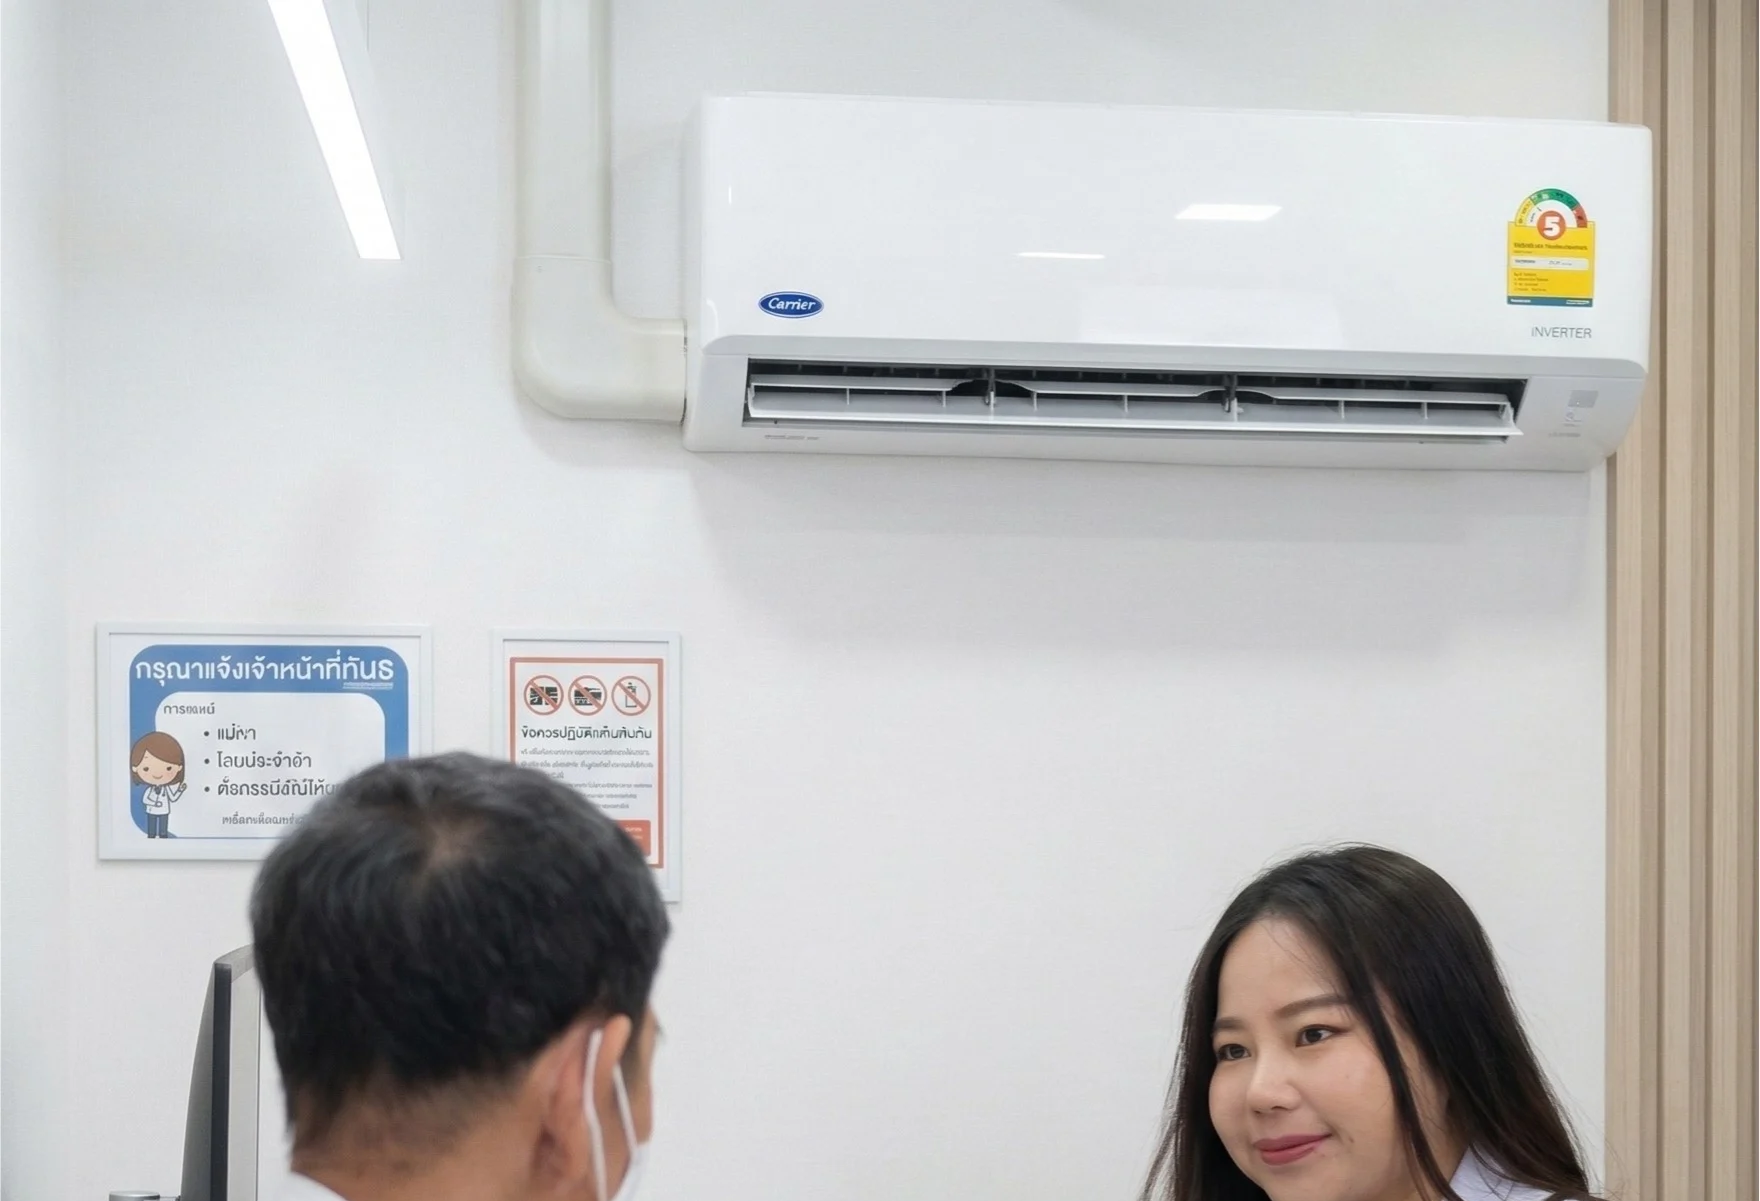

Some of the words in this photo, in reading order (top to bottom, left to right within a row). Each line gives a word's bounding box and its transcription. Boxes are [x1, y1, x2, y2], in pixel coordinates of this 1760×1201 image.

[1543, 215, 1560, 237] 5
[767, 297, 816, 311] Carrier
[1531, 326, 1592, 339] INVERTER
